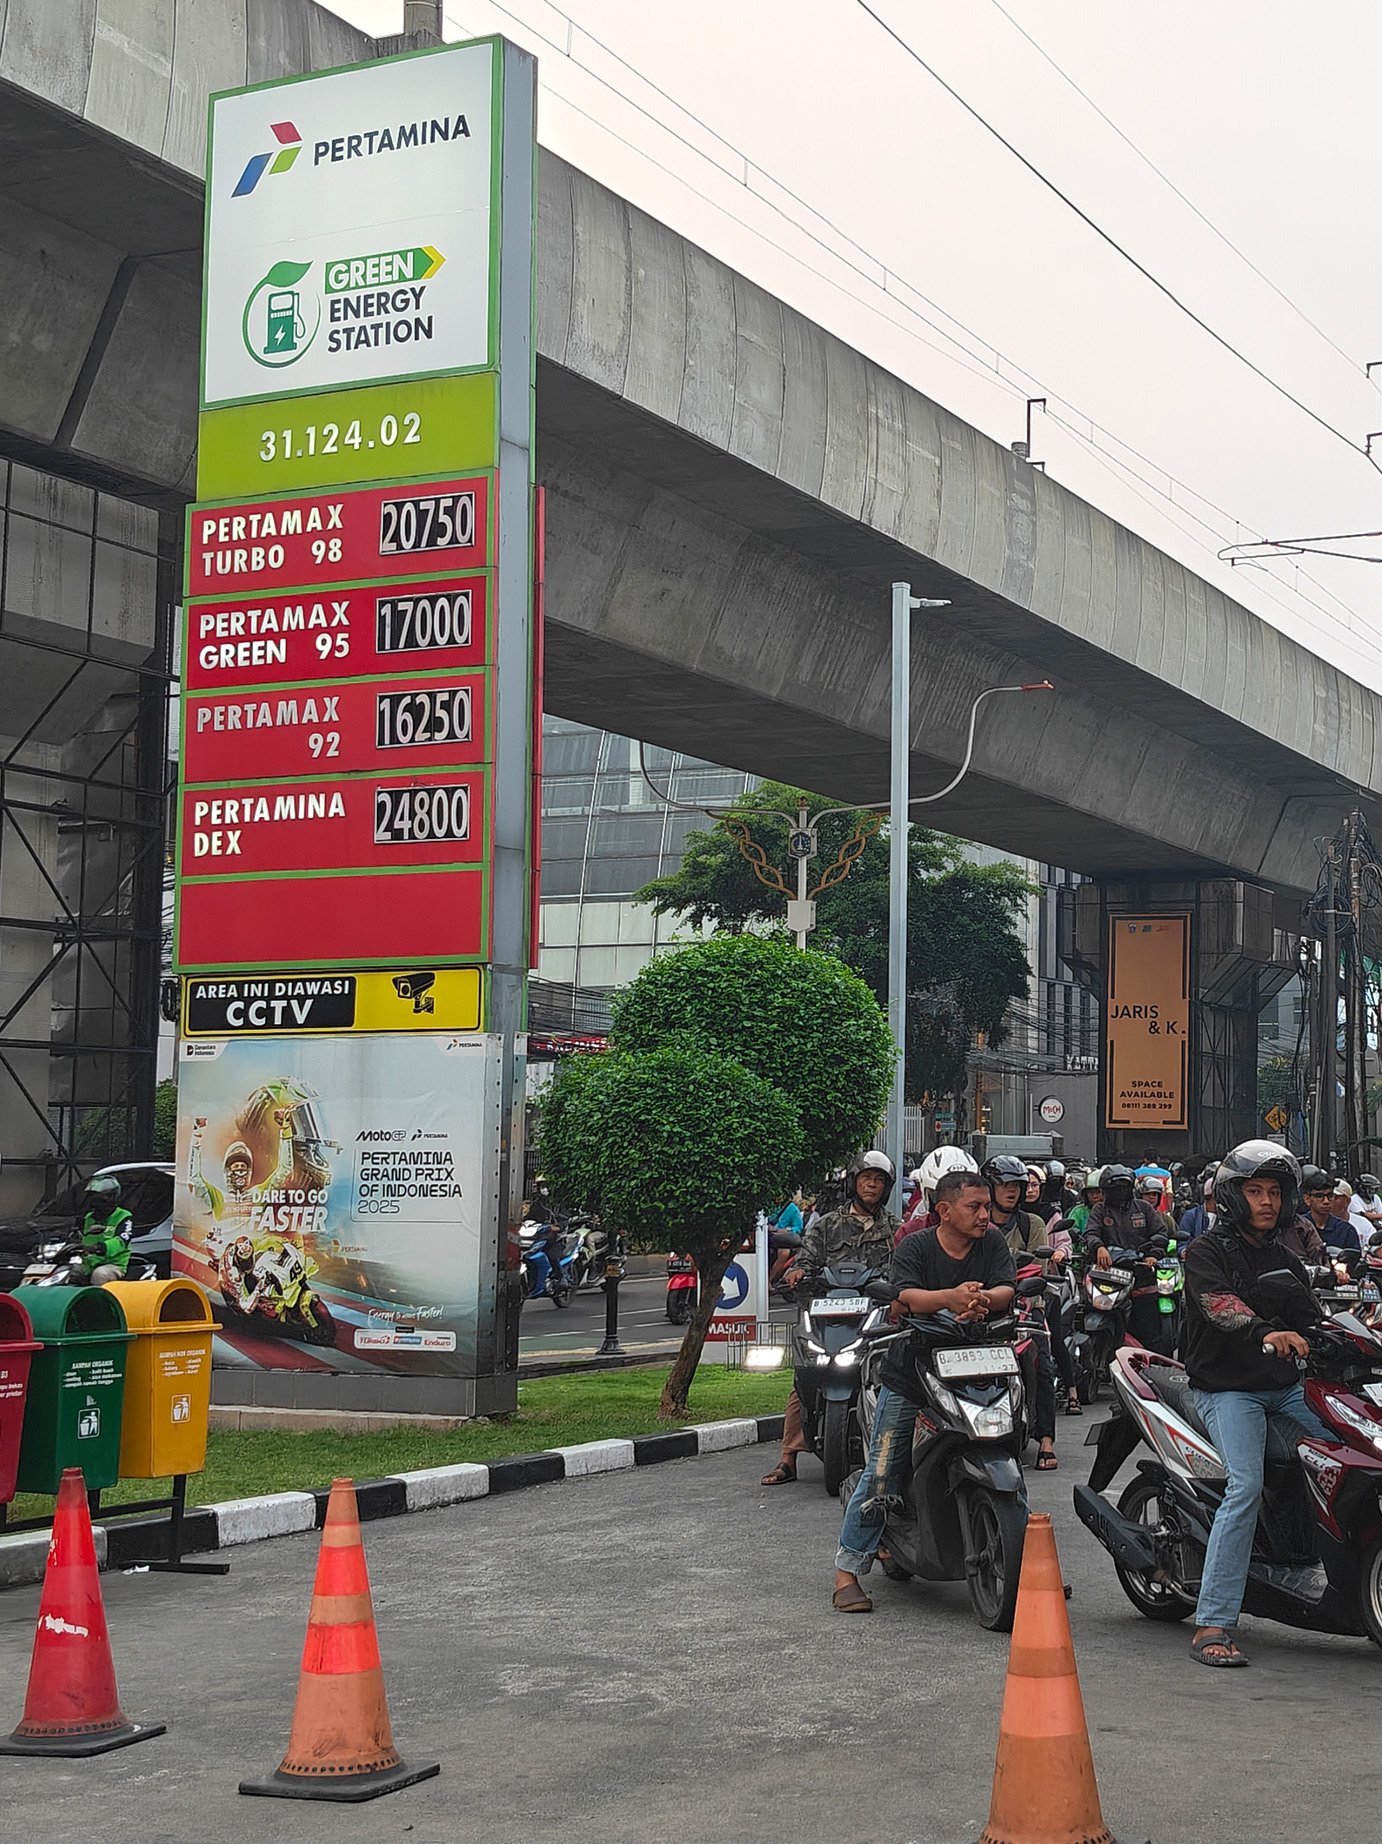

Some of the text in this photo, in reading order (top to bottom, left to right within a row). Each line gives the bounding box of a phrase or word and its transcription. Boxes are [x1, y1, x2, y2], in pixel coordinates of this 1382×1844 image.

[314, 114, 471, 166] PERTAMINA
[328, 251, 414, 290] GREEN
[329, 286, 427, 323] ENERGY
[327, 315, 434, 353] STATION
[259, 412, 422, 462] 31.124.02
[202, 504, 344, 545] PERTAMAX
[382, 494, 473, 551] 20750
[202, 538, 343, 576] TURBO 98
[199, 601, 350, 639] PERTAMAX
[380, 594, 470, 650] 17000
[199, 632, 350, 669] GREEN 95
[197, 696, 340, 732] PERTAMAX
[379, 690, 470, 745] 16250
[308, 732, 340, 758] 92
[194, 791, 346, 826] PERTAMINA
[376, 787, 469, 840] 24800
[193, 830, 242, 857] DEX
[195, 979, 350, 999] AREA INI DIAWASI
[226, 999, 315, 1027] CCTV
[1111, 1005, 1159, 1019] JARIS
[1148, 1021, 1161, 1035] &
[1120, 1091, 1175, 1099] AVAILABLE
[1131, 1080, 1163, 1088] SPACE
[361, 1151, 453, 1165] PERTAMINA
[360, 1167, 455, 1181] GRAND PRIX
[251, 1189, 328, 1204] DARE TO GO
[359, 1184, 462, 1198] OF INDONESIA
[250, 1206, 328, 1232] FASTER
[358, 1200, 400, 1214] 2025
[708, 1323, 750, 1335] MASUK
